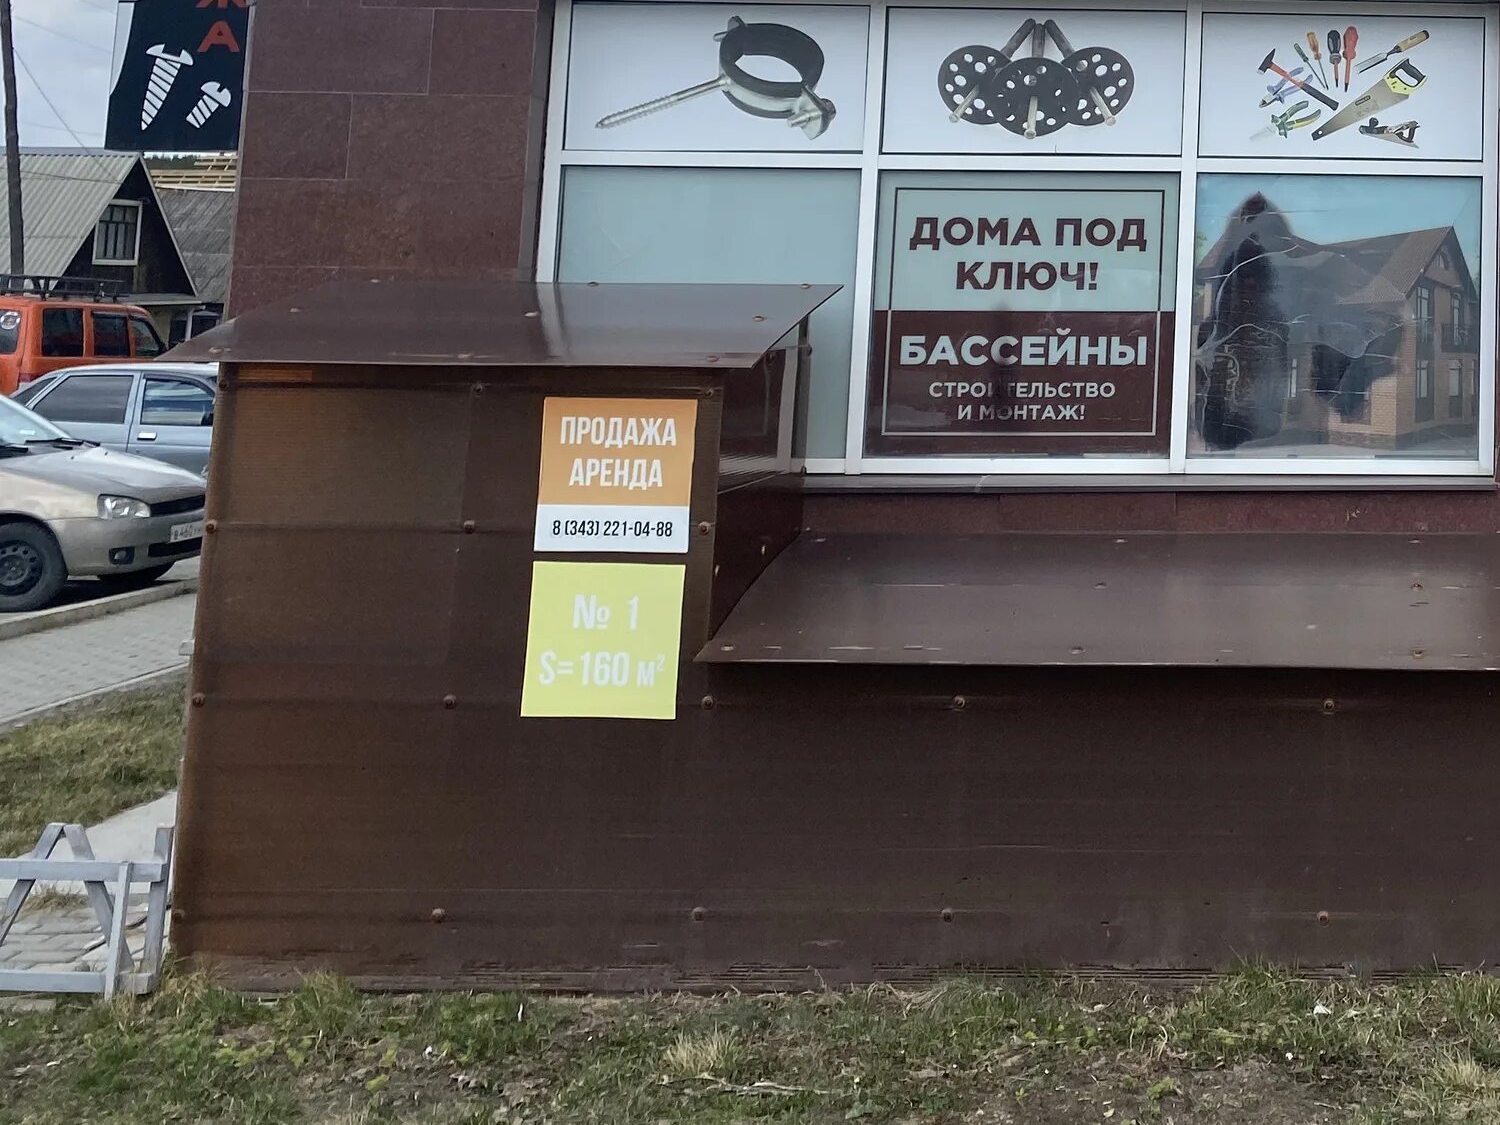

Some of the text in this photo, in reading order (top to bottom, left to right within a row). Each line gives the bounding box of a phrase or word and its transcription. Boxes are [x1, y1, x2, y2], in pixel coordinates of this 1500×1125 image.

[909, 217, 1147, 252] ДОМА ПОД
[955, 261, 1099, 290] КЛЮЧ!
[900, 327, 1147, 366] БАССЕЙНЫ
[957, 405, 1085, 420] И МОНТАЖ!
[560, 416, 677, 447] ПРОДАЖА
[569, 458, 663, 490] АРЕНДА
[552, 520, 673, 537] 8 (343) 221-04-88
[572, 594, 640, 630] № 1
